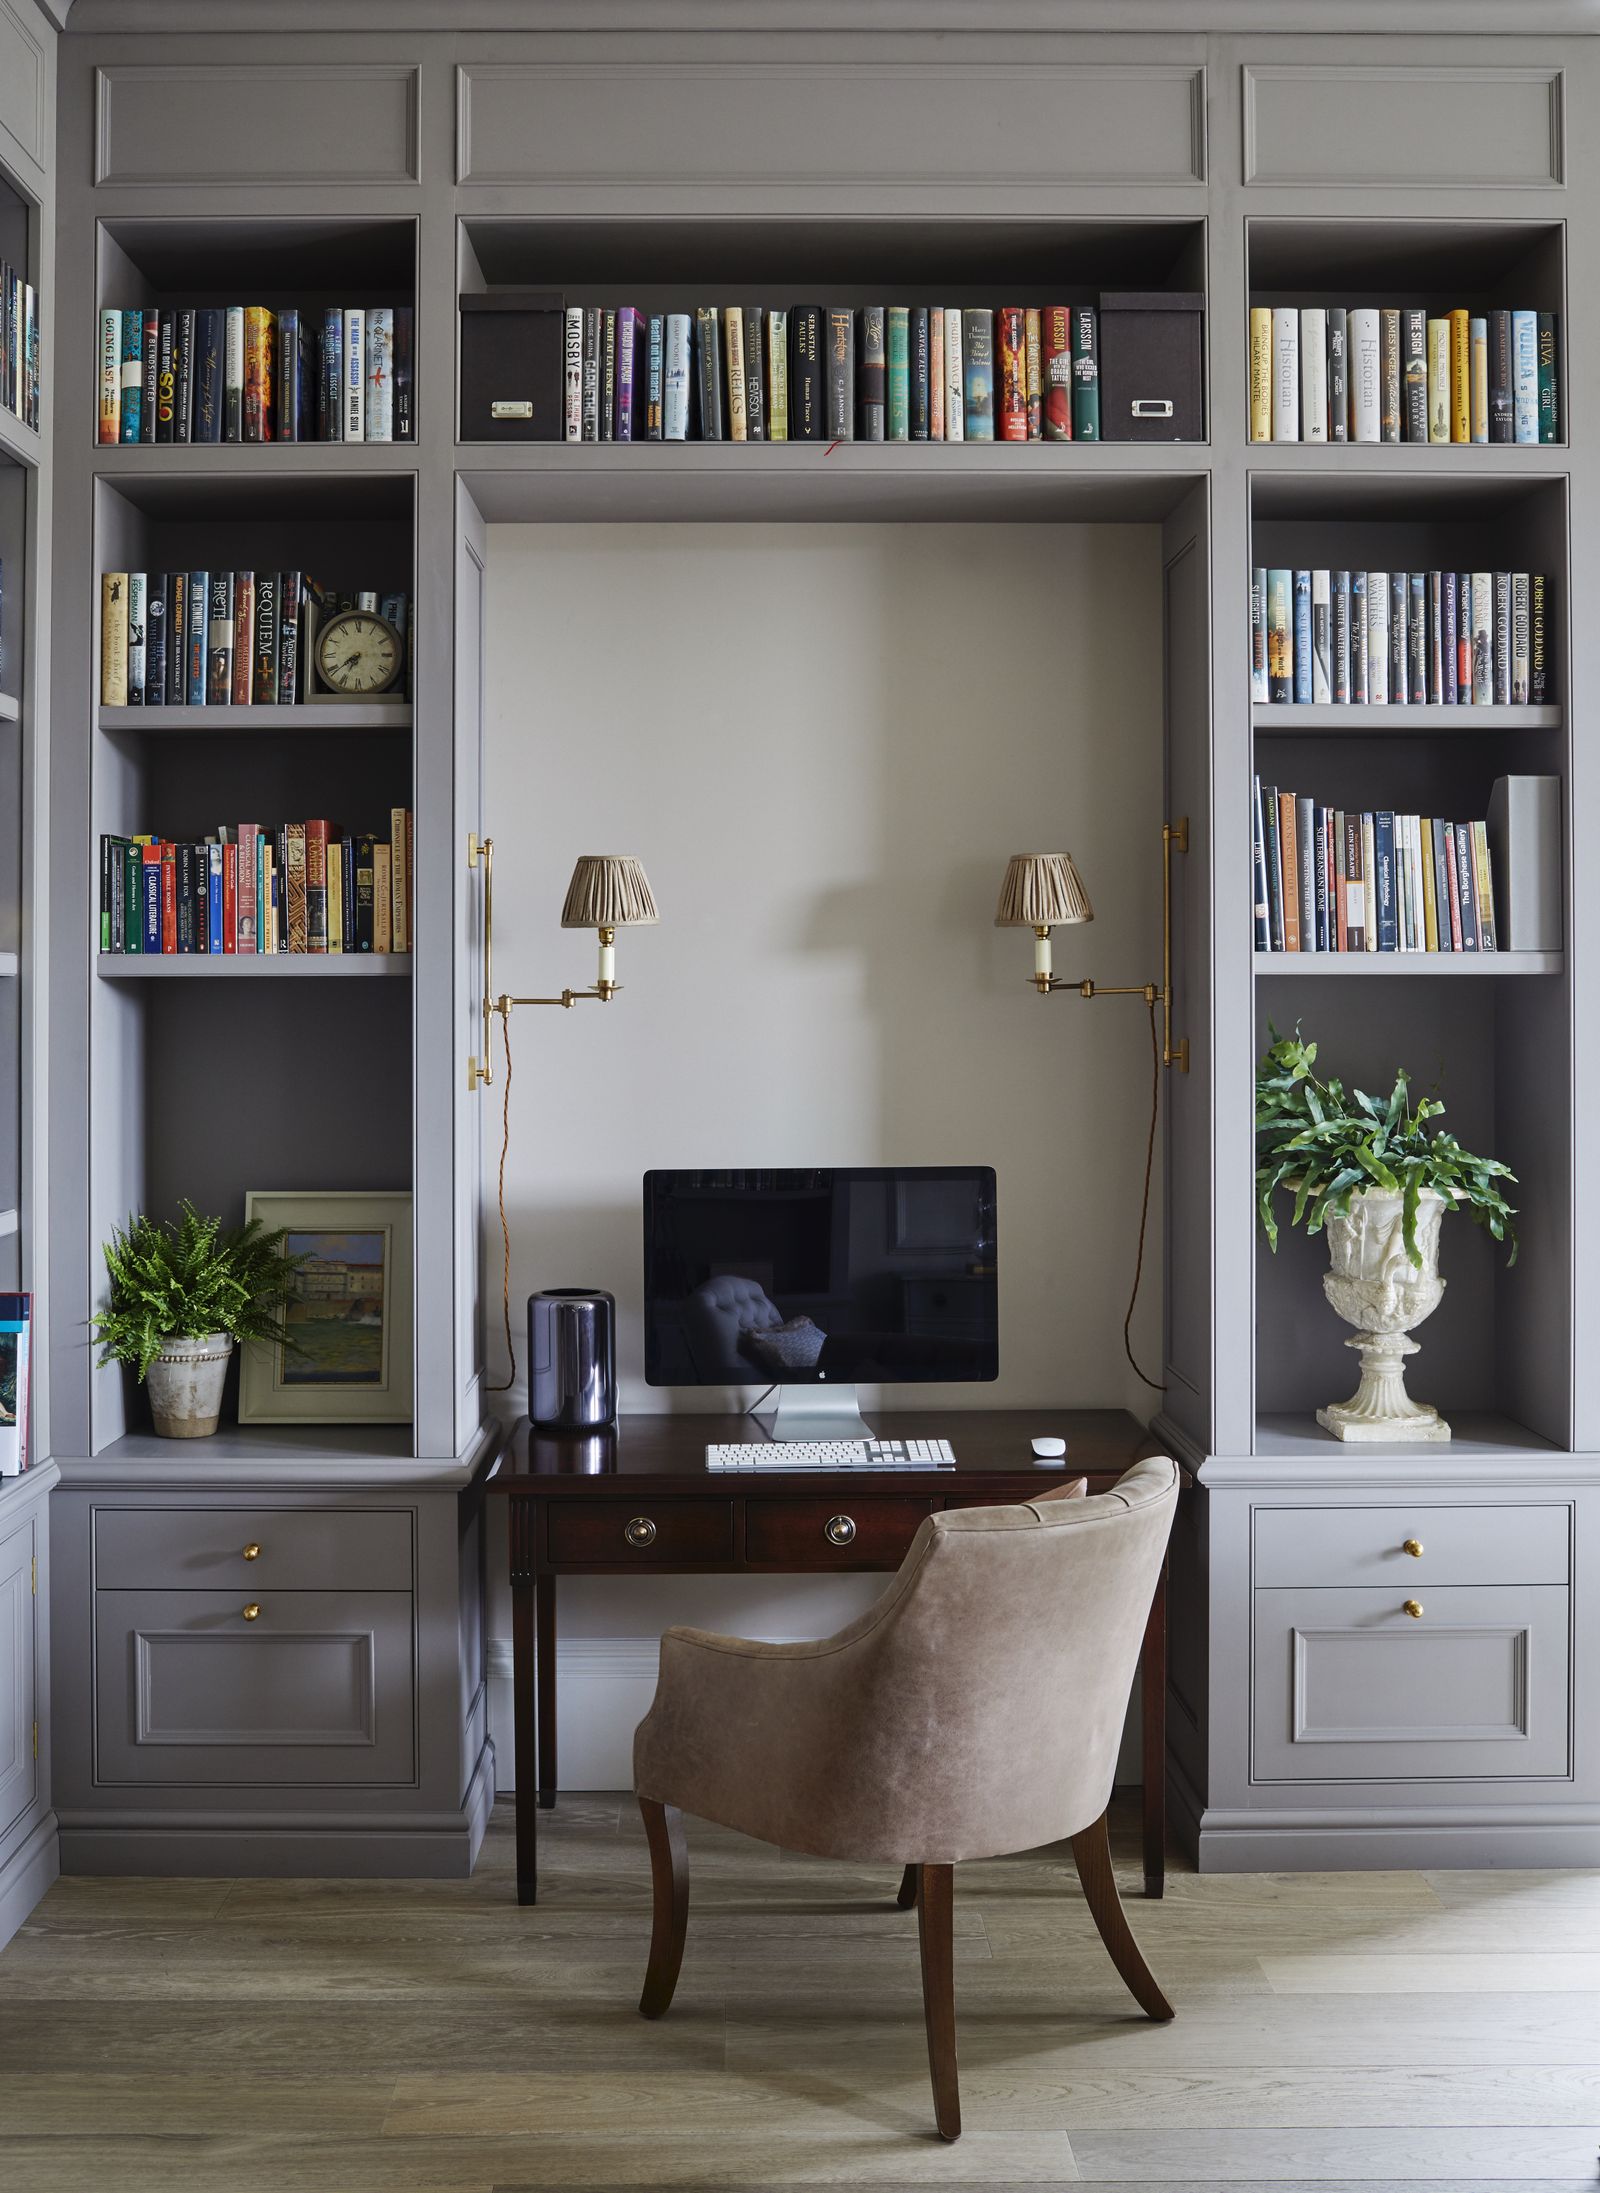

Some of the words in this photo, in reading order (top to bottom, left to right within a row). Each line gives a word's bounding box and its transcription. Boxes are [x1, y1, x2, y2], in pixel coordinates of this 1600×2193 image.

[181, 314, 191, 337] DEVIL
[230, 316, 239, 347] WILLIAM
[350, 317, 361, 327] THE
[374, 311, 384, 326] MR
[586, 313, 595, 337] DENISE
[605, 315, 615, 341] DEATH
[650, 319, 662, 344] death
[672, 319, 681, 342] SHARP
[1053, 310, 1064, 350] LARSSON
[1080, 312, 1092, 350] LARSSON
[1388, 315, 1397, 344] JAMES
[1411, 312, 1421, 331] THE
[104, 317, 115, 353] GOING
[161, 323, 172, 354] WILLIAM
[180, 338, 190, 356] MAY
[284, 332, 292, 356] MINETTE
[325, 324, 336, 364] SLAUGHTER
[350, 328, 360, 345] MARK
[373, 326, 385, 368] CLARINET
[566, 320, 582, 368] MOSBY
[586, 339, 595, 358] MINA
[605, 343, 615, 353] AT
[621, 321, 633, 348] RICHARD
[704, 331, 713, 355] LIBRARY
[749, 321, 757, 365] MYSTERIES
[798, 321, 807, 355] FAULKS
[808, 313, 816, 361] SEBASTIAN
[918, 328, 926, 357] SAVAGE
[951, 322, 961, 349] RUBY
[1411, 332, 1422, 355] SIGN
[1541, 331, 1552, 367] SILVA
[605, 355, 615, 366] LA
[650, 345, 660, 356] on
[650, 357, 662, 371] the
[672, 343, 681, 367] NORTH
[1253, 336, 1261, 366] HILARY
[1262, 353, 1269, 365] UP
[104, 354, 115, 385] EAST
[147, 337, 157, 402] BLINDSIGHTED
[180, 357, 189, 380] CARE
[229, 348, 239, 385] BRODRICK
[284, 357, 292, 381] WALTERS
[350, 357, 360, 386] ASSASSIN
[621, 348, 633, 384] MONTANARI
[1261, 368, 1269, 383] THE
[1280, 338, 1296, 409] Historian
[1361, 338, 1377, 409] Historian
[158, 371, 175, 422] SOLO
[180, 382, 188, 403] SEBASTIAN
[329, 371, 338, 401] KISSCUT
[584, 360, 597, 423] GARNETHILL
[604, 368, 614, 397] FENICE
[650, 371, 661, 403] marais
[730, 369, 744, 415] RELICS
[748, 376, 759, 417] HEWSON
[804, 377, 812, 400] Human
[1253, 369, 1261, 403] MANTEL
[350, 395, 360, 415] DANIEL
[804, 402, 812, 422] Traces
[837, 394, 845, 424] SANSOM
[1261, 385, 1269, 416] BODIES
[1411, 389, 1419, 427] KHOURY
[1542, 387, 1551, 411] GIRL
[178, 423, 187, 438] 007
[350, 416, 360, 432] SILVA
[131, 578, 139, 623] FESPERMAN
[175, 576, 184, 604] MICHAEL
[191, 583, 204, 601] JOHN
[1252, 585, 1260, 624] SLAUGHTER
[1368, 578, 1379, 628] WALTERS
[1461, 581, 1470, 609] Michael
[1497, 575, 1508, 613] ROBERT
[1515, 577, 1528, 611] ROBERT
[1534, 575, 1545, 614] ROBERT
[174, 604, 184, 633] CONNELLY
[191, 602, 203, 636] CONNOLLY
[1276, 606, 1286, 630] BURKE
[1338, 594, 1346, 625] MINETTE
[113, 620, 122, 633] the
[1301, 613, 1309, 651] SUICIDE
[1352, 621, 1360, 634] The
[1461, 611, 1470, 640] Connelly
[1515, 614, 1528, 658] GODDARD
[113, 635, 122, 656] book
[148, 619, 158, 681] WHISPERERS
[156, 640, 165, 660] THE
[287, 638, 295, 669] Andrew
[1255, 631, 1265, 669] TRIPTYCH
[1338, 627, 1346, 657] WALTERS
[1351, 635, 1360, 653] Echo
[1497, 616, 1508, 669] GODDARD
[1534, 616, 1545, 670] GODDARD
[113, 658, 122, 681] thief
[1301, 656, 1309, 683] CLUB
[1418, 639, 1426, 676] WALTERS
[394, 818, 402, 853] CHRONICLE
[1458, 828, 1467, 856] Gallery
[395, 854, 402, 863] OF
[1254, 842, 1263, 865] LIBYA
[1316, 826, 1325, 888] SUBTERRANEAN
[1348, 843, 1356, 878] EPIGRAPHY
[380, 864, 388, 885] ROME
[1286, 840, 1295, 897] SCULPTURE
[1460, 855, 1469, 891] Borghese
[148, 875, 158, 904] CLASSICAL
[395, 877, 403, 899] ROMAN
[1317, 888, 1325, 912] ROME
[1383, 879, 1391, 907] Mythology
[1462, 891, 1470, 906] The
[148, 904, 158, 935] LITERATURE
[380, 895, 388, 936] JERUSALEM
[395, 900, 403, 934] EMPERORS
[1304, 901, 1312, 921] DEAD
